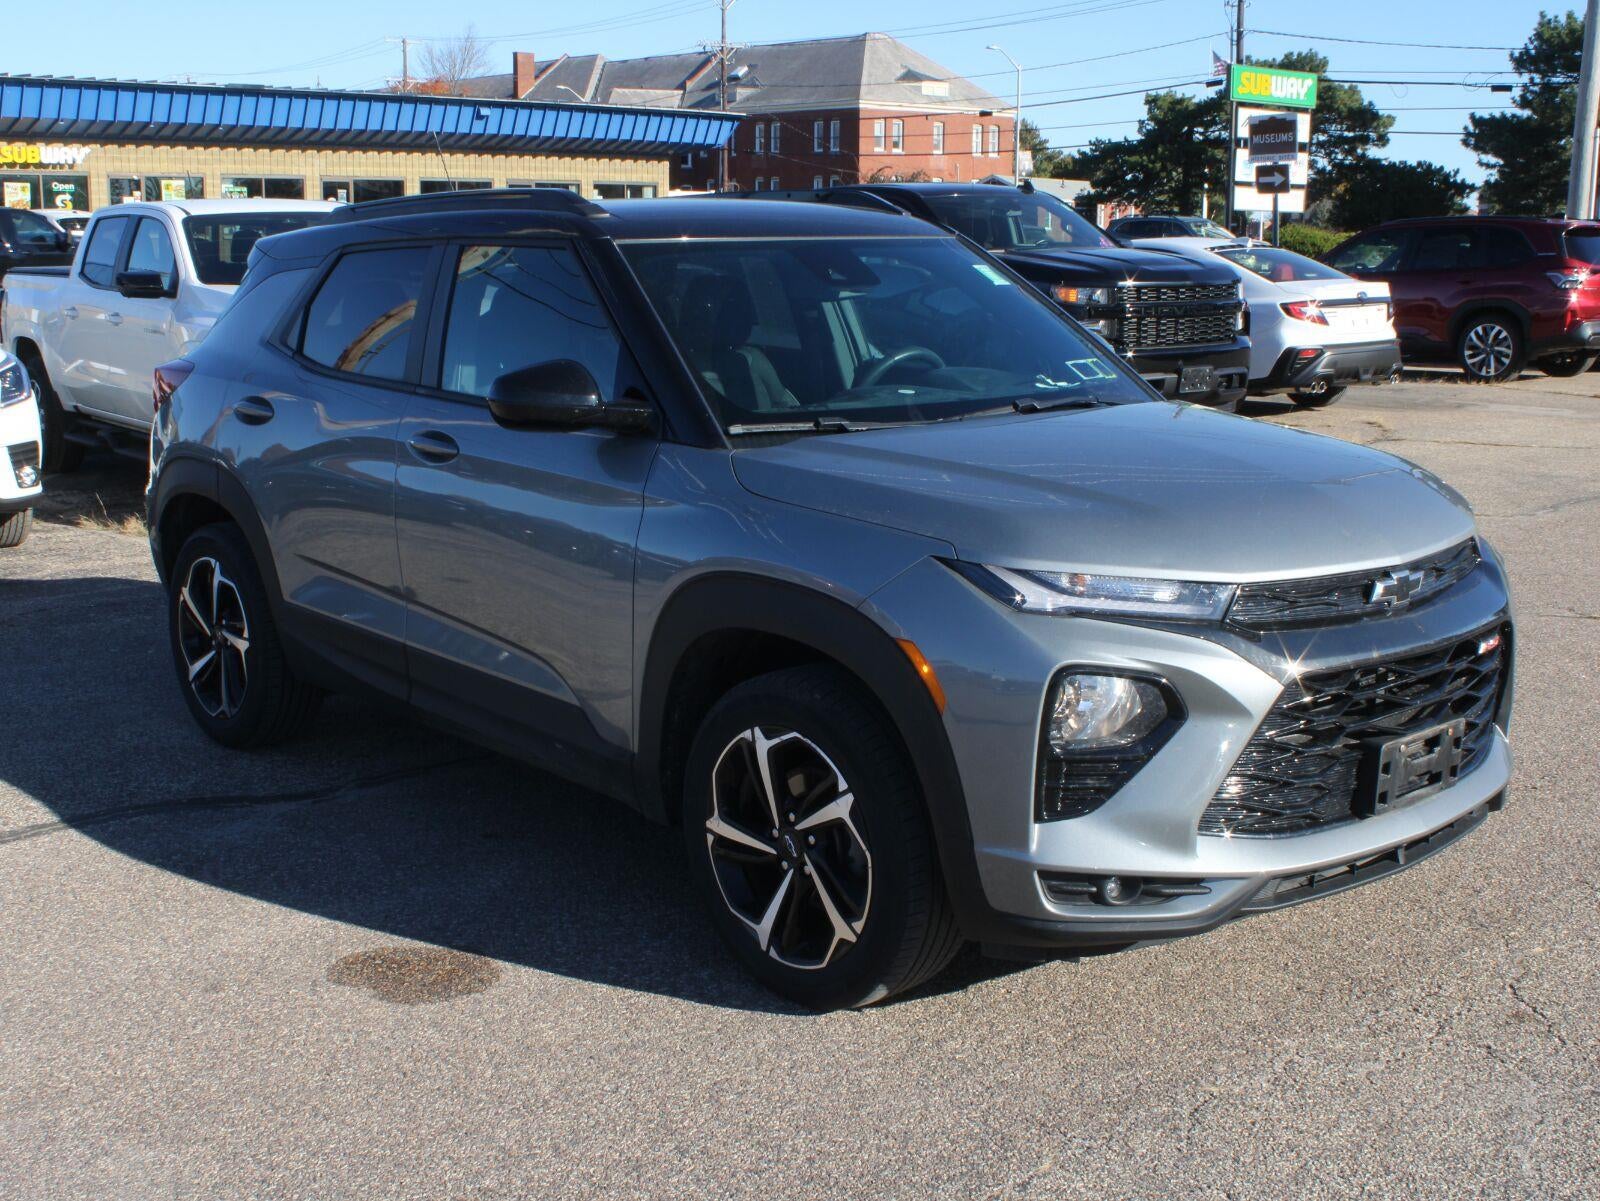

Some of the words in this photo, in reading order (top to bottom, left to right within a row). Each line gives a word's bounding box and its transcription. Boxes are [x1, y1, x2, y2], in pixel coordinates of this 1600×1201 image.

[1237, 71, 1313, 100] SUBWAY
[1252, 132, 1294, 145] MUSEUMS
[0, 145, 91, 164] SUBWAY
[52, 182, 75, 191] Open
